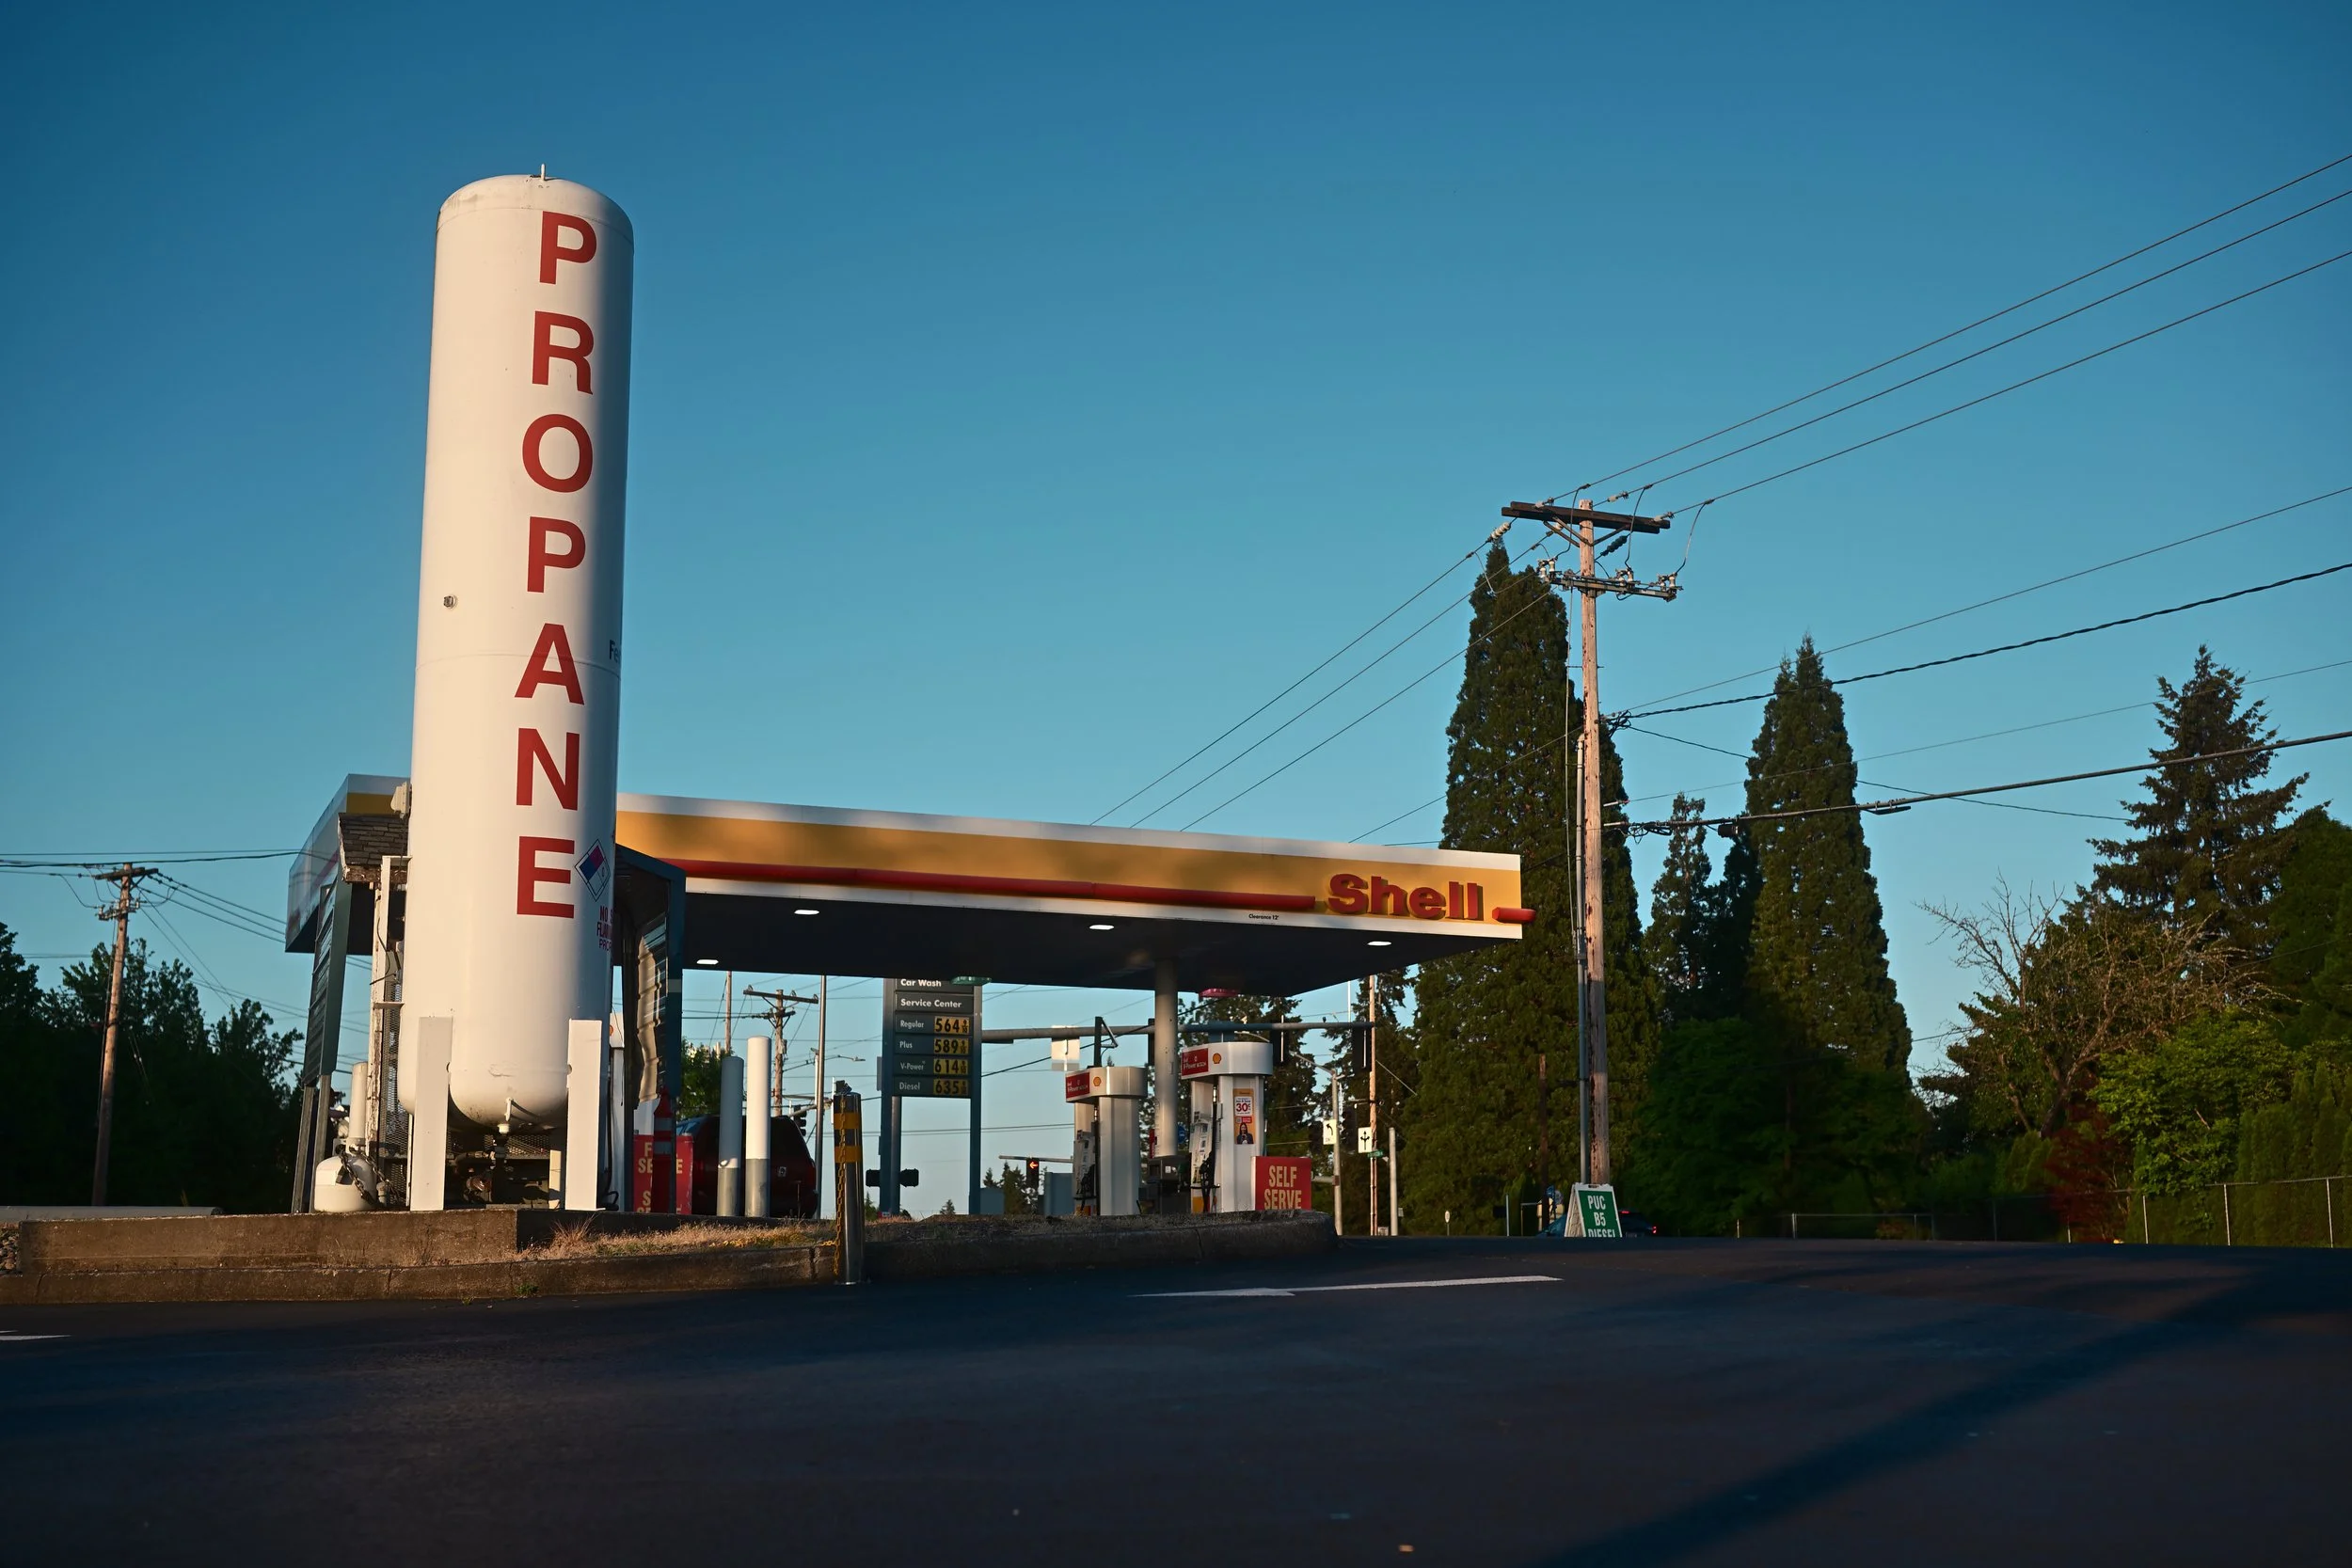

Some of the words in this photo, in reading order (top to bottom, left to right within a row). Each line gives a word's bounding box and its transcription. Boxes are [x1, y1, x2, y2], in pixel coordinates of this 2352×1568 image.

[514, 210, 598, 919] PROPANE
[609, 639, 621, 664] Fe
[1327, 873, 1482, 920] Shell
[900, 978, 916, 987] Car
[918, 979, 942, 988] Wash
[900, 998, 931, 1007] Service
[933, 999, 961, 1008] Center
[899, 1019, 925, 1030] Regular
[934, 1018, 960, 1033] 564
[899, 1040, 913, 1049] Plus
[934, 1038, 959, 1053] 589
[934, 1059, 959, 1073] 614
[898, 1081, 921, 1090] Diesel
[935, 1080, 959, 1095] 635
[638, 1157, 683, 1175] SEE
[1268, 1164, 1297, 1188] SELF
[1263, 1188, 1302, 1210] SERVE
[1587, 1195, 1607, 1211] PUC
[1593, 1212, 1607, 1227] B5
